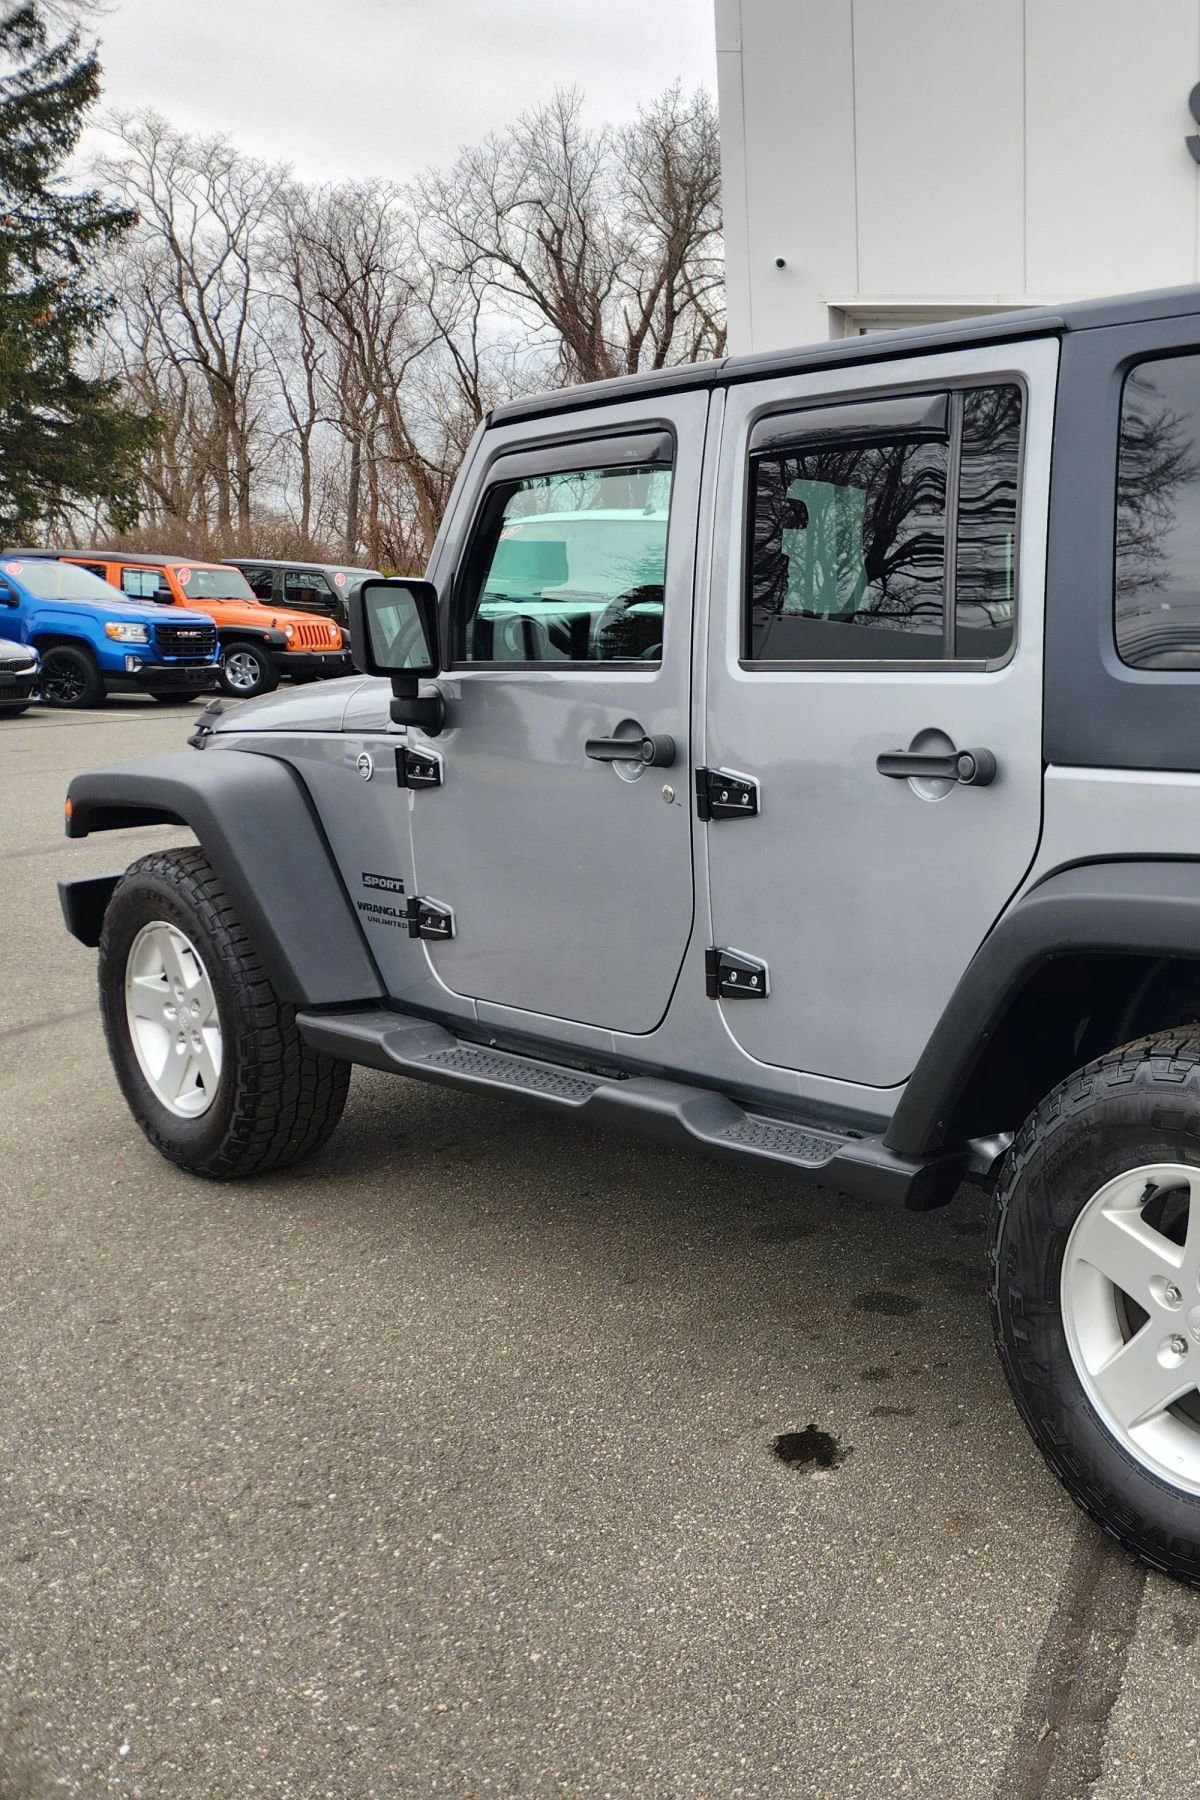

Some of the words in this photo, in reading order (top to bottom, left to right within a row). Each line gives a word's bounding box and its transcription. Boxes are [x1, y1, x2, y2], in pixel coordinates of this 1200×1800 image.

[363, 874, 402, 891] SPORT
[357, 901, 408, 919] WRANGLE
[367, 916, 408, 929] UNLIMITED
